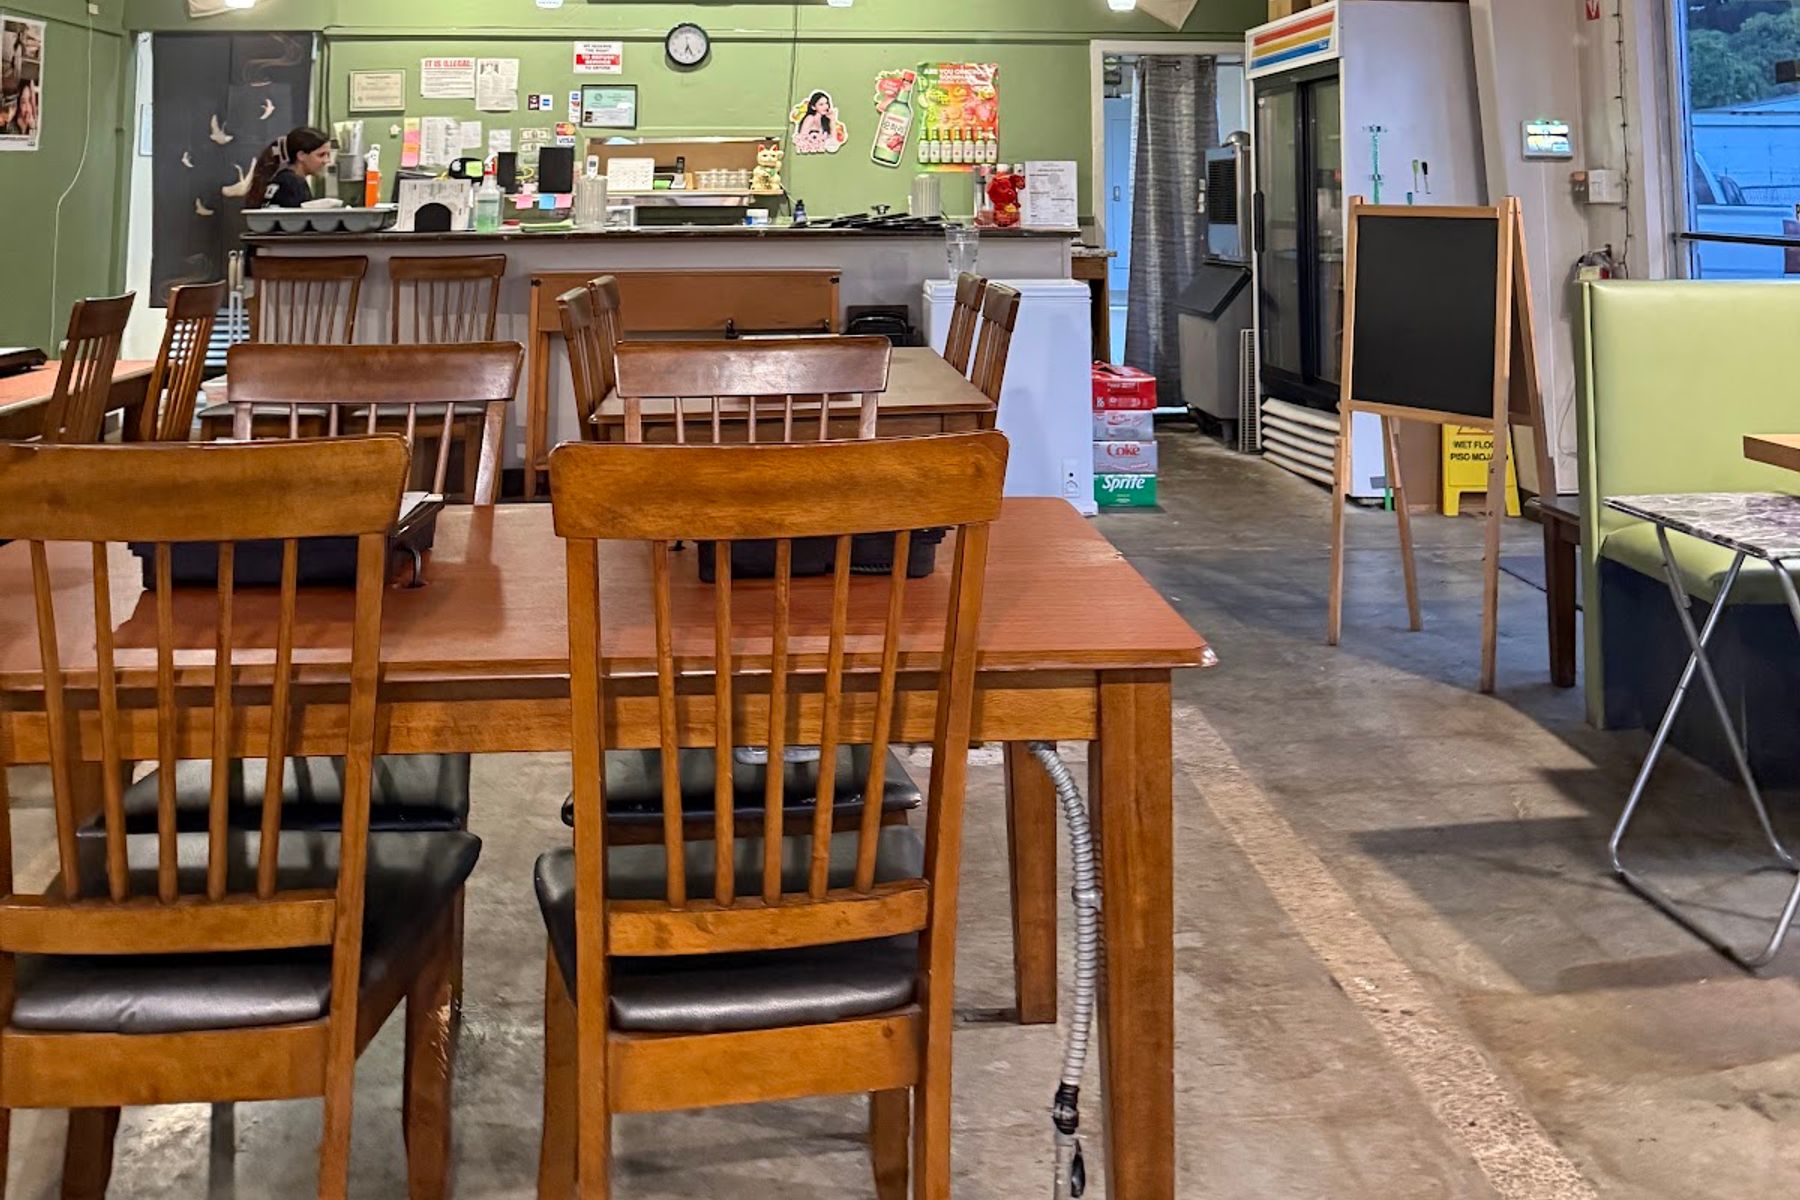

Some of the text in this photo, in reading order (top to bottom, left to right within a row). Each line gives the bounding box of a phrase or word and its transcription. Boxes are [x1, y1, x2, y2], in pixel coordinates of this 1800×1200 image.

[1107, 442, 1140, 457] Coke
[1453, 440, 1494, 449] WET FLO
[1450, 452, 1471, 461] PISO
[1102, 474, 1145, 492] Sprite
